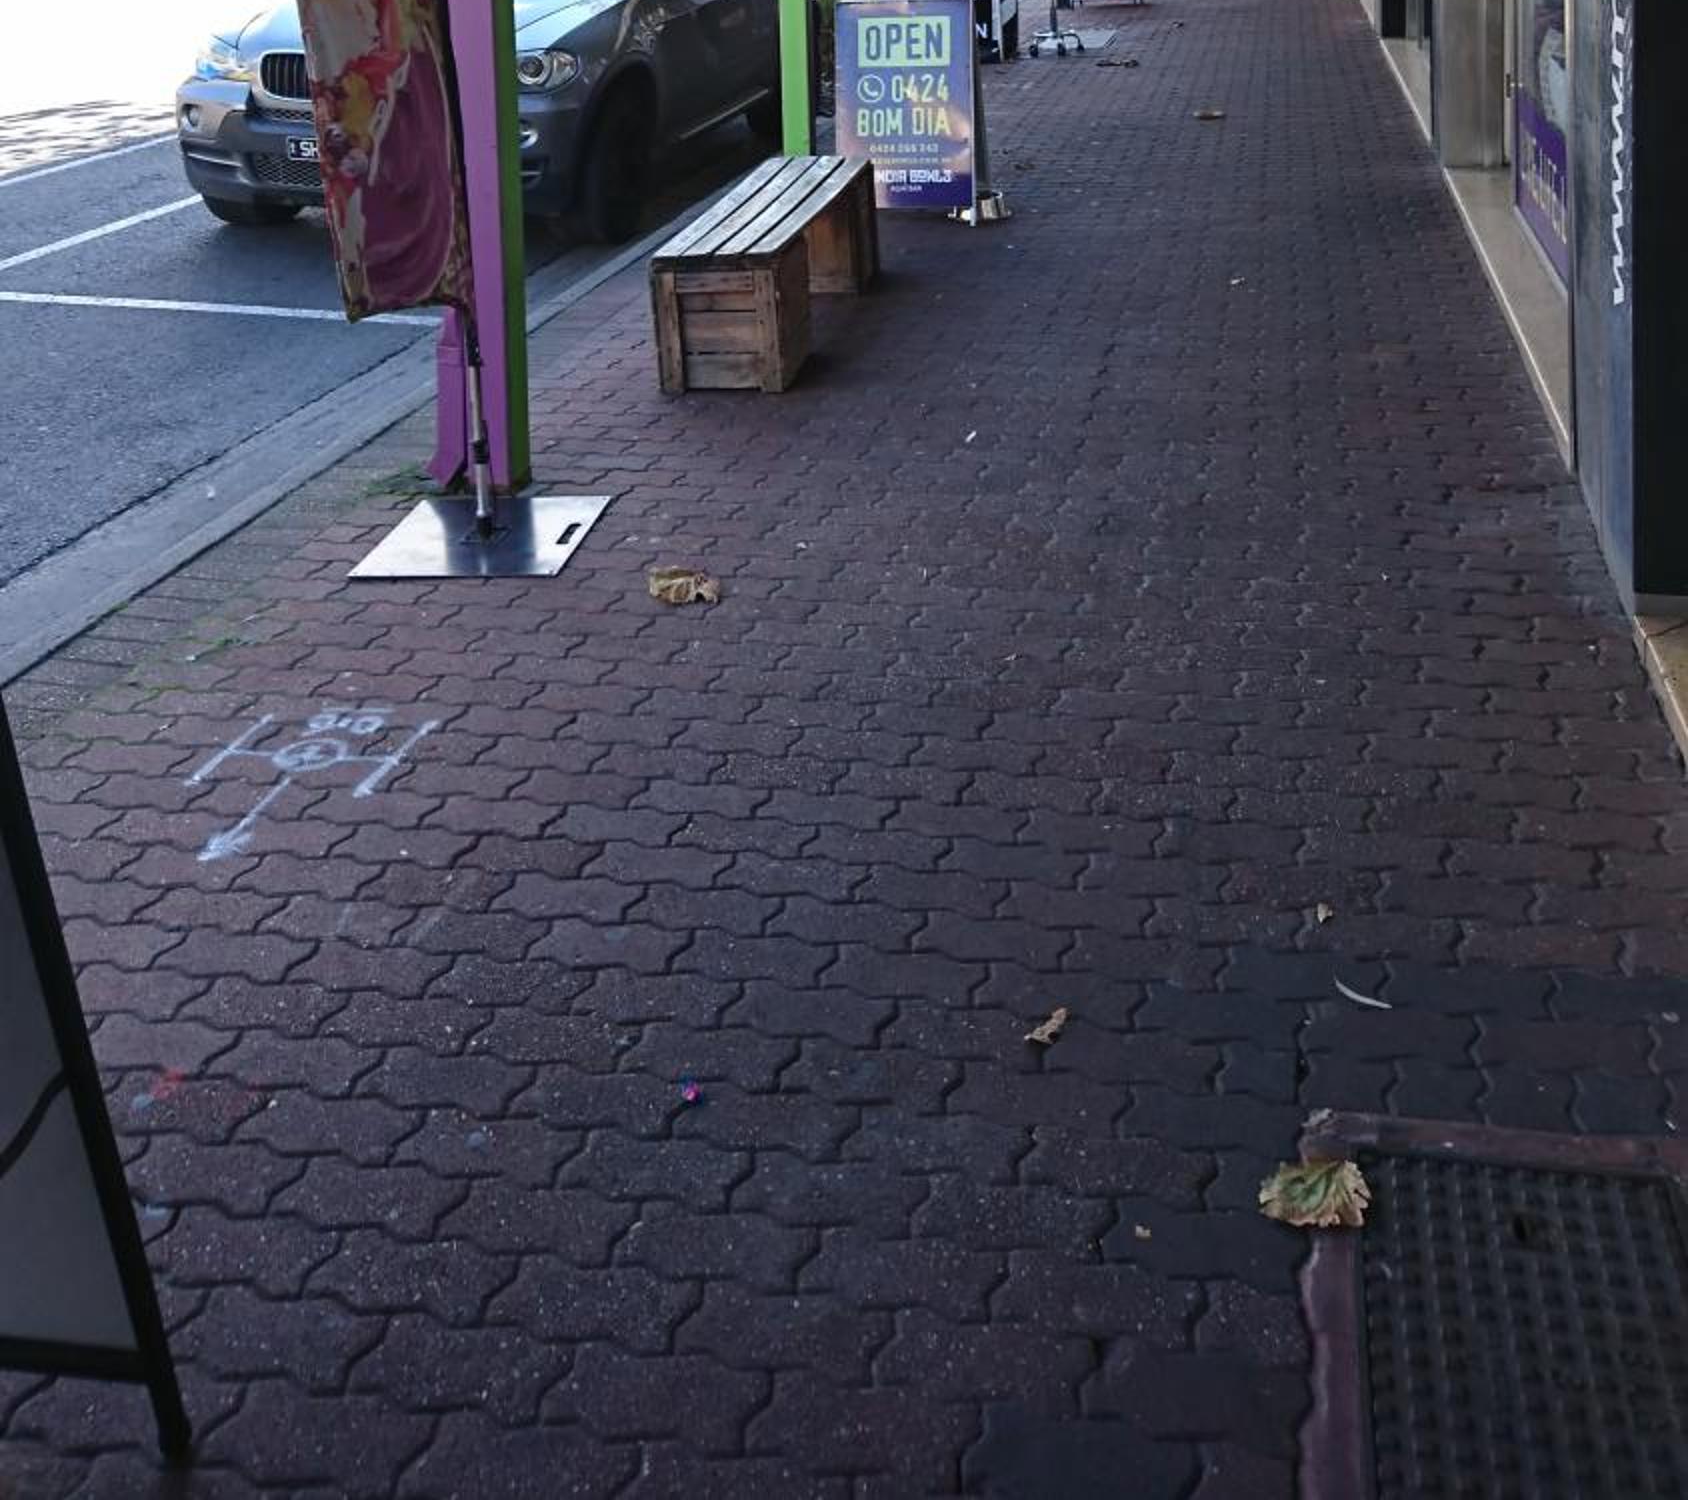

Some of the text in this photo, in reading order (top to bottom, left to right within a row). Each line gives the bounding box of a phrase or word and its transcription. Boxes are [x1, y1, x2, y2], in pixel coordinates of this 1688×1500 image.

[865, 23, 943, 61] OPEN
[891, 73, 949, 103] 0424
[857, 106, 952, 137] BOM DIA
